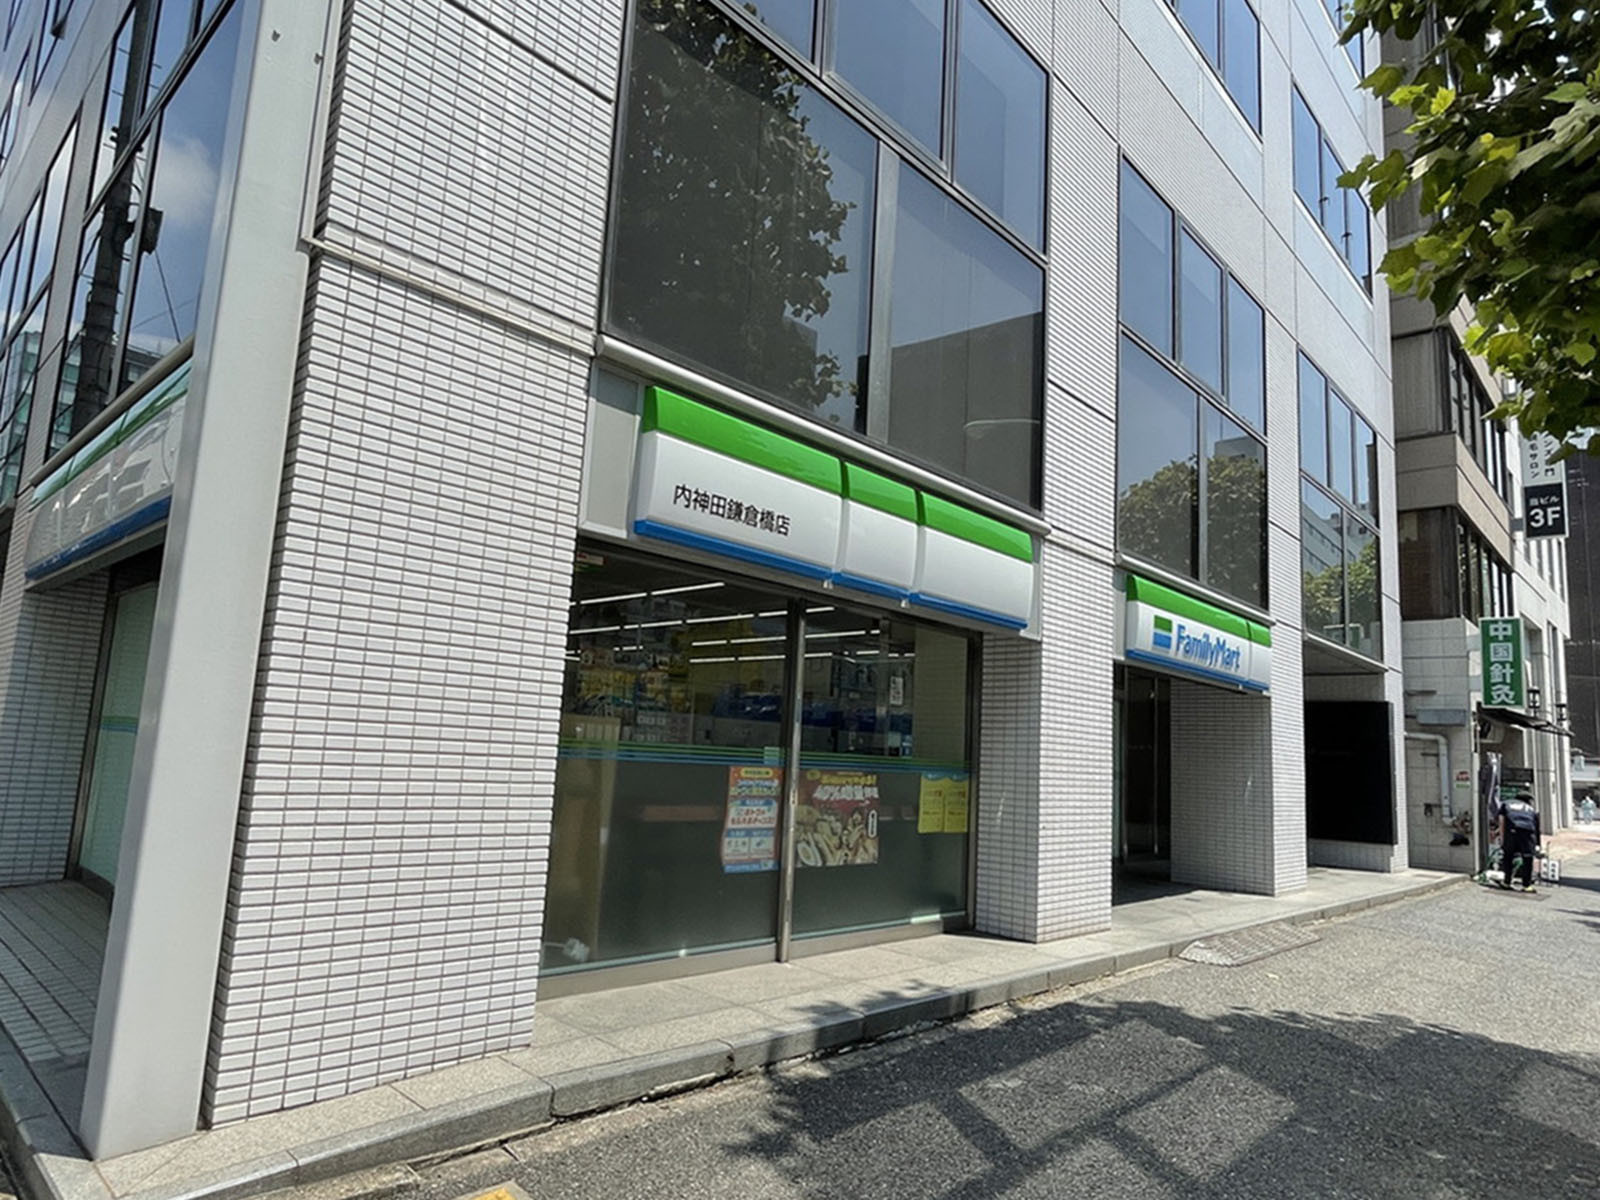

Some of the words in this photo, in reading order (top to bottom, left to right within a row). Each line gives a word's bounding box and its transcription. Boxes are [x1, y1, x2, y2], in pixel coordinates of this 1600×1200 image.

[673, 484, 790, 536] 内神田鎌倉橋店
[1529, 507, 1561, 528] 3F
[1176, 623, 1241, 670] FamilyMart
[1489, 621, 1516, 704] 中国針灸
